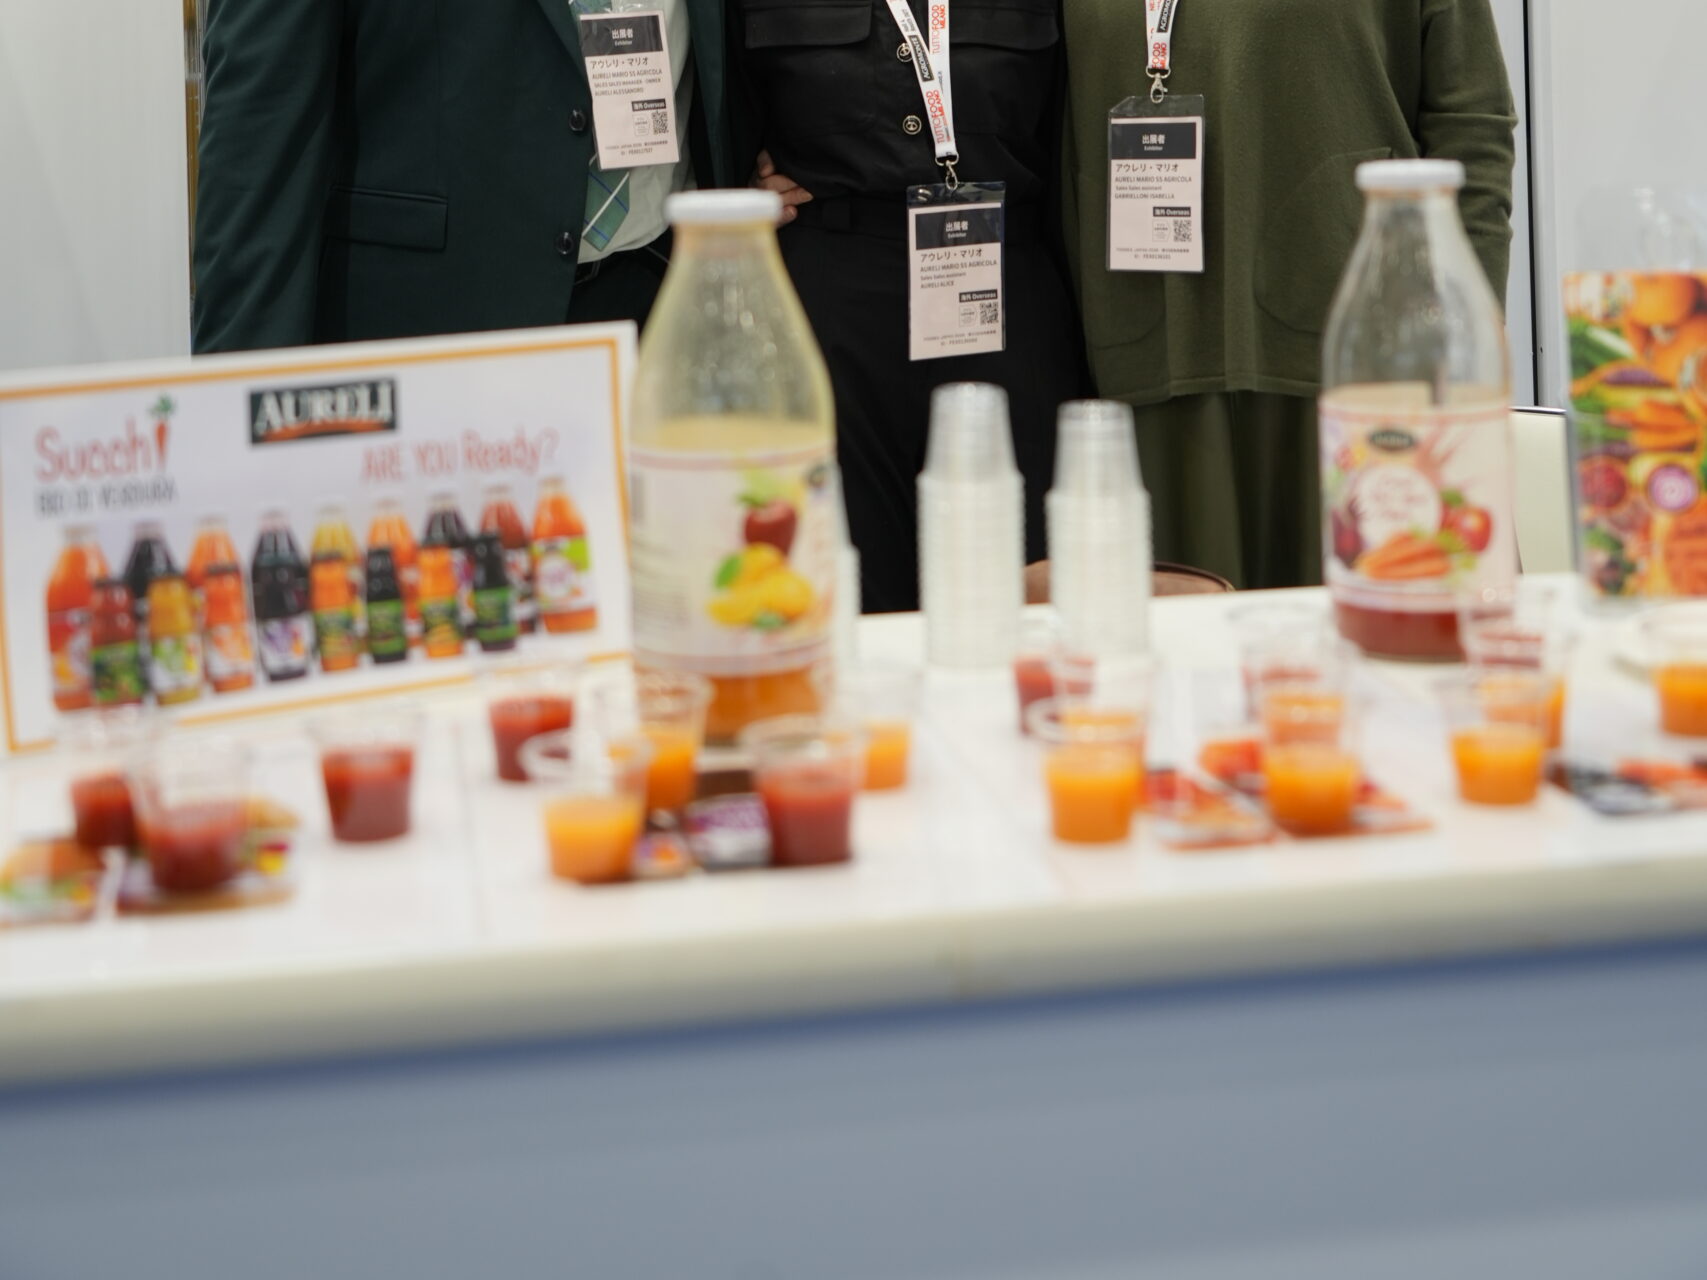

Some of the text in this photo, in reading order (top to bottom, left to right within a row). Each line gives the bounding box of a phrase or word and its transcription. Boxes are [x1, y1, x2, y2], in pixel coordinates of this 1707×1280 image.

[911, 37, 931, 79] AGROMONTE
[926, 91, 945, 143] TUTTOFOOD
[920, 248, 982, 262] アウレリ・マリオ
[254, 381, 393, 434] AURELI
